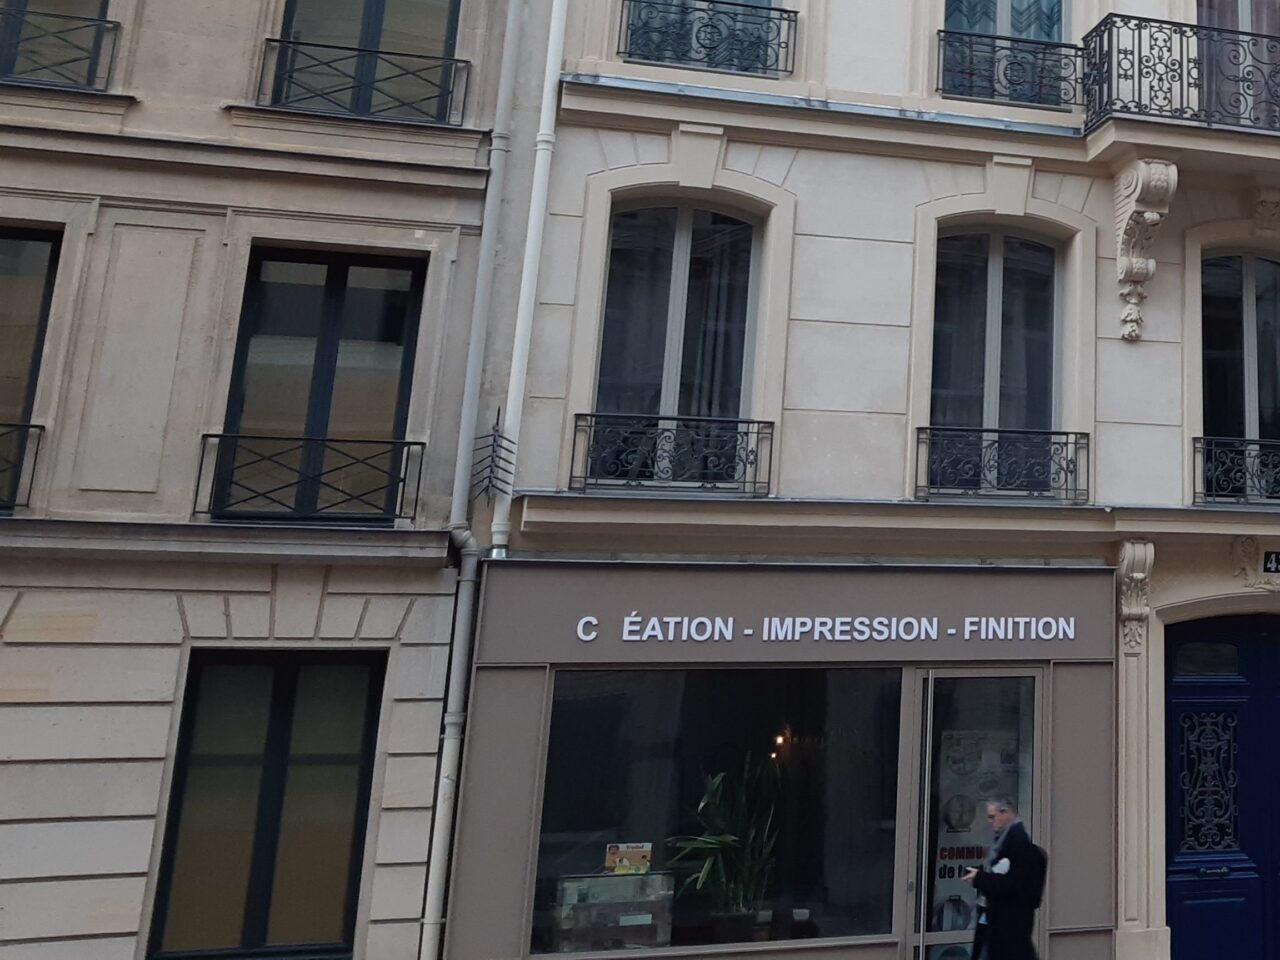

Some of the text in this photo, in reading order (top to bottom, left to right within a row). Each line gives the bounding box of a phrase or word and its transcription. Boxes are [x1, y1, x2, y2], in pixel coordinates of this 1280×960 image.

[762, 617, 938, 641] IMPRESSION
[964, 616, 1075, 640] FINITION
[939, 864, 955, 879] de
